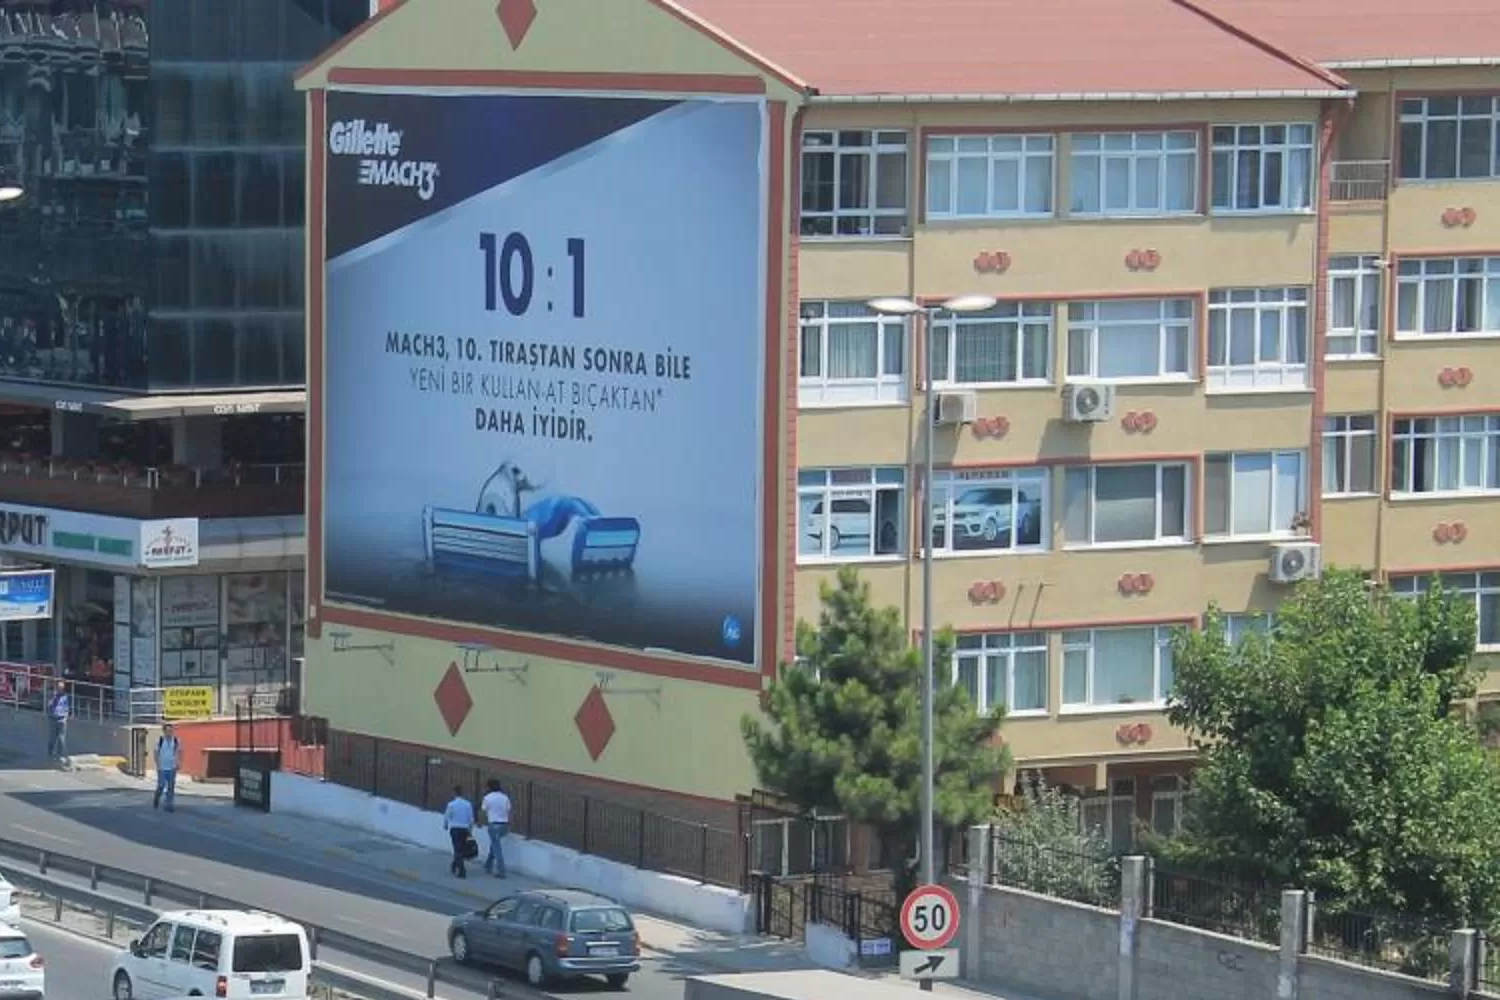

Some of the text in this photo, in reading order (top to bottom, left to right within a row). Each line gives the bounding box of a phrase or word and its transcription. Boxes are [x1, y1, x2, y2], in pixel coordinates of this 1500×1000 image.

[329, 119, 402, 157] Gillette
[357, 159, 438, 201] MACH3
[385, 331, 692, 380] MACH3, 10. TIRAŞTAN SONRA BİLE
[409, 365, 446, 393] YENİ
[451, 370, 474, 395] BİR
[480, 375, 565, 406] KULLAN-AT
[474, 405, 594, 442] DAHA İYİDİR.
[914, 904, 946, 933] 50
